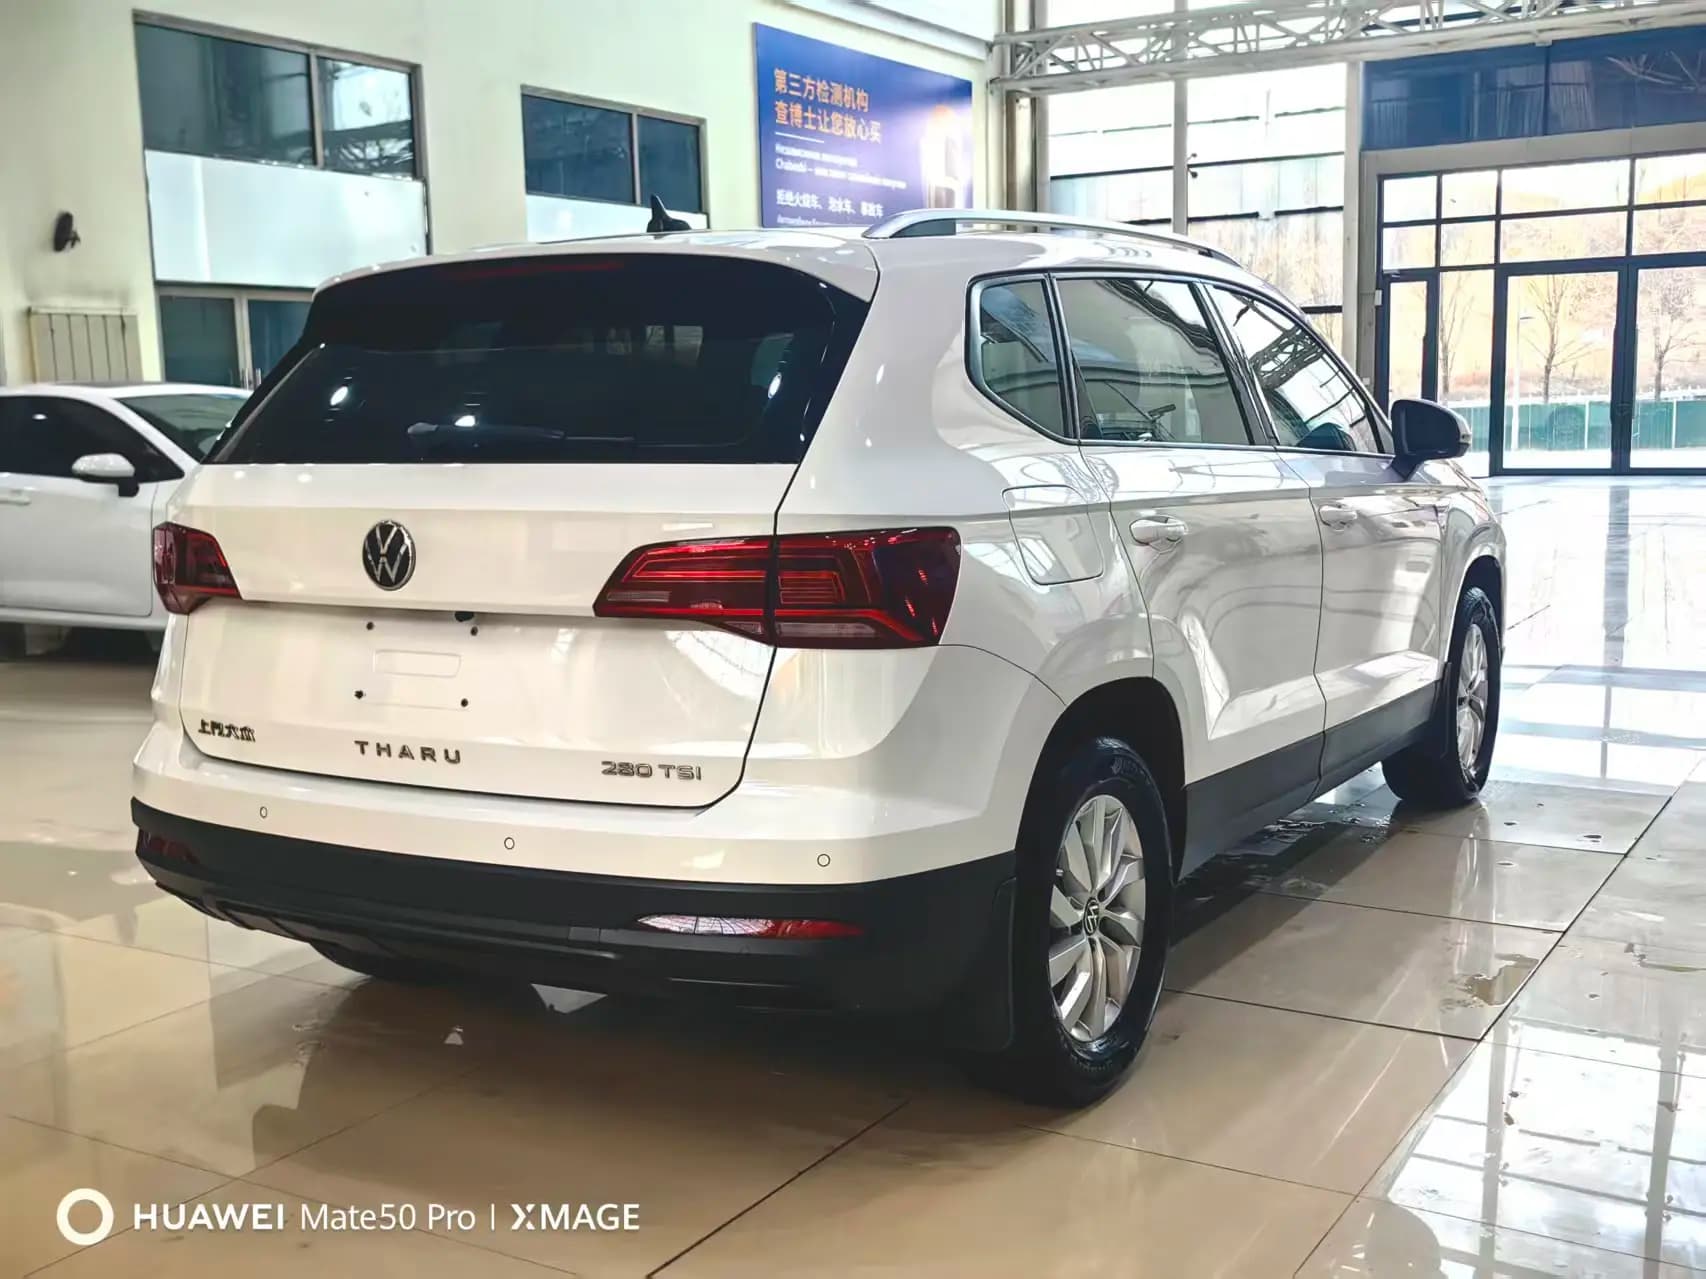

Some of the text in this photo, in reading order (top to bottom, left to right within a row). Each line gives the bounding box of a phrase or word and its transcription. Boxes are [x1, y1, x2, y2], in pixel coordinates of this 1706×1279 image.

[774, 68, 869, 113] 第三方检测机构
[775, 100, 882, 144] 查博士让您放心买
[355, 740, 461, 764] THARU
[601, 760, 702, 780] 280 TSI
